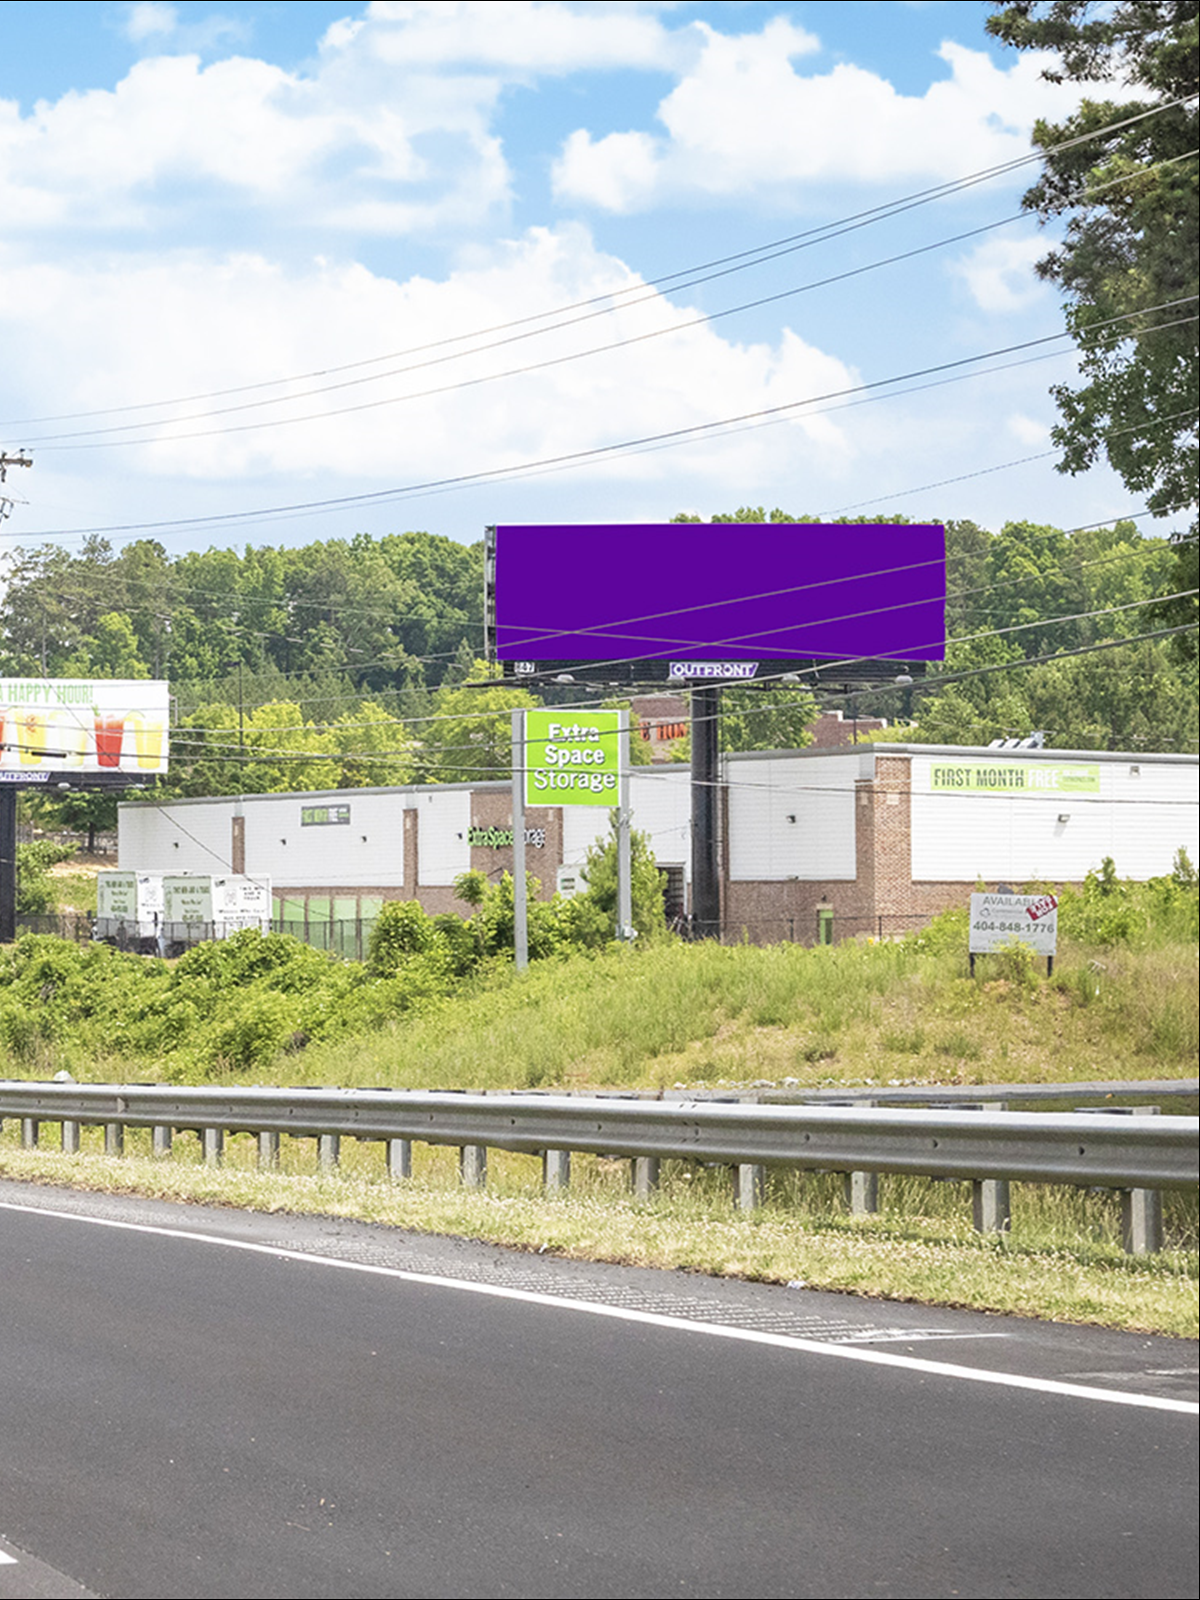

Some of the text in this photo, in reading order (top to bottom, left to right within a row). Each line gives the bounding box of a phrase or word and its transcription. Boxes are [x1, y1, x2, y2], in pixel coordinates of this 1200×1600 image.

[672, 663, 753, 676] OUTFRONT
[8, 684, 51, 703] HAPPY
[57, 685, 94, 704] HOUR!
[549, 723, 600, 742] Extra
[544, 745, 606, 768] Space
[533, 769, 616, 792] Storage
[934, 768, 972, 787] FIRST
[976, 769, 1025, 787] MONTH
[1028, 769, 1060, 788] FREE
[973, 920, 1055, 934] 404-848-1776
